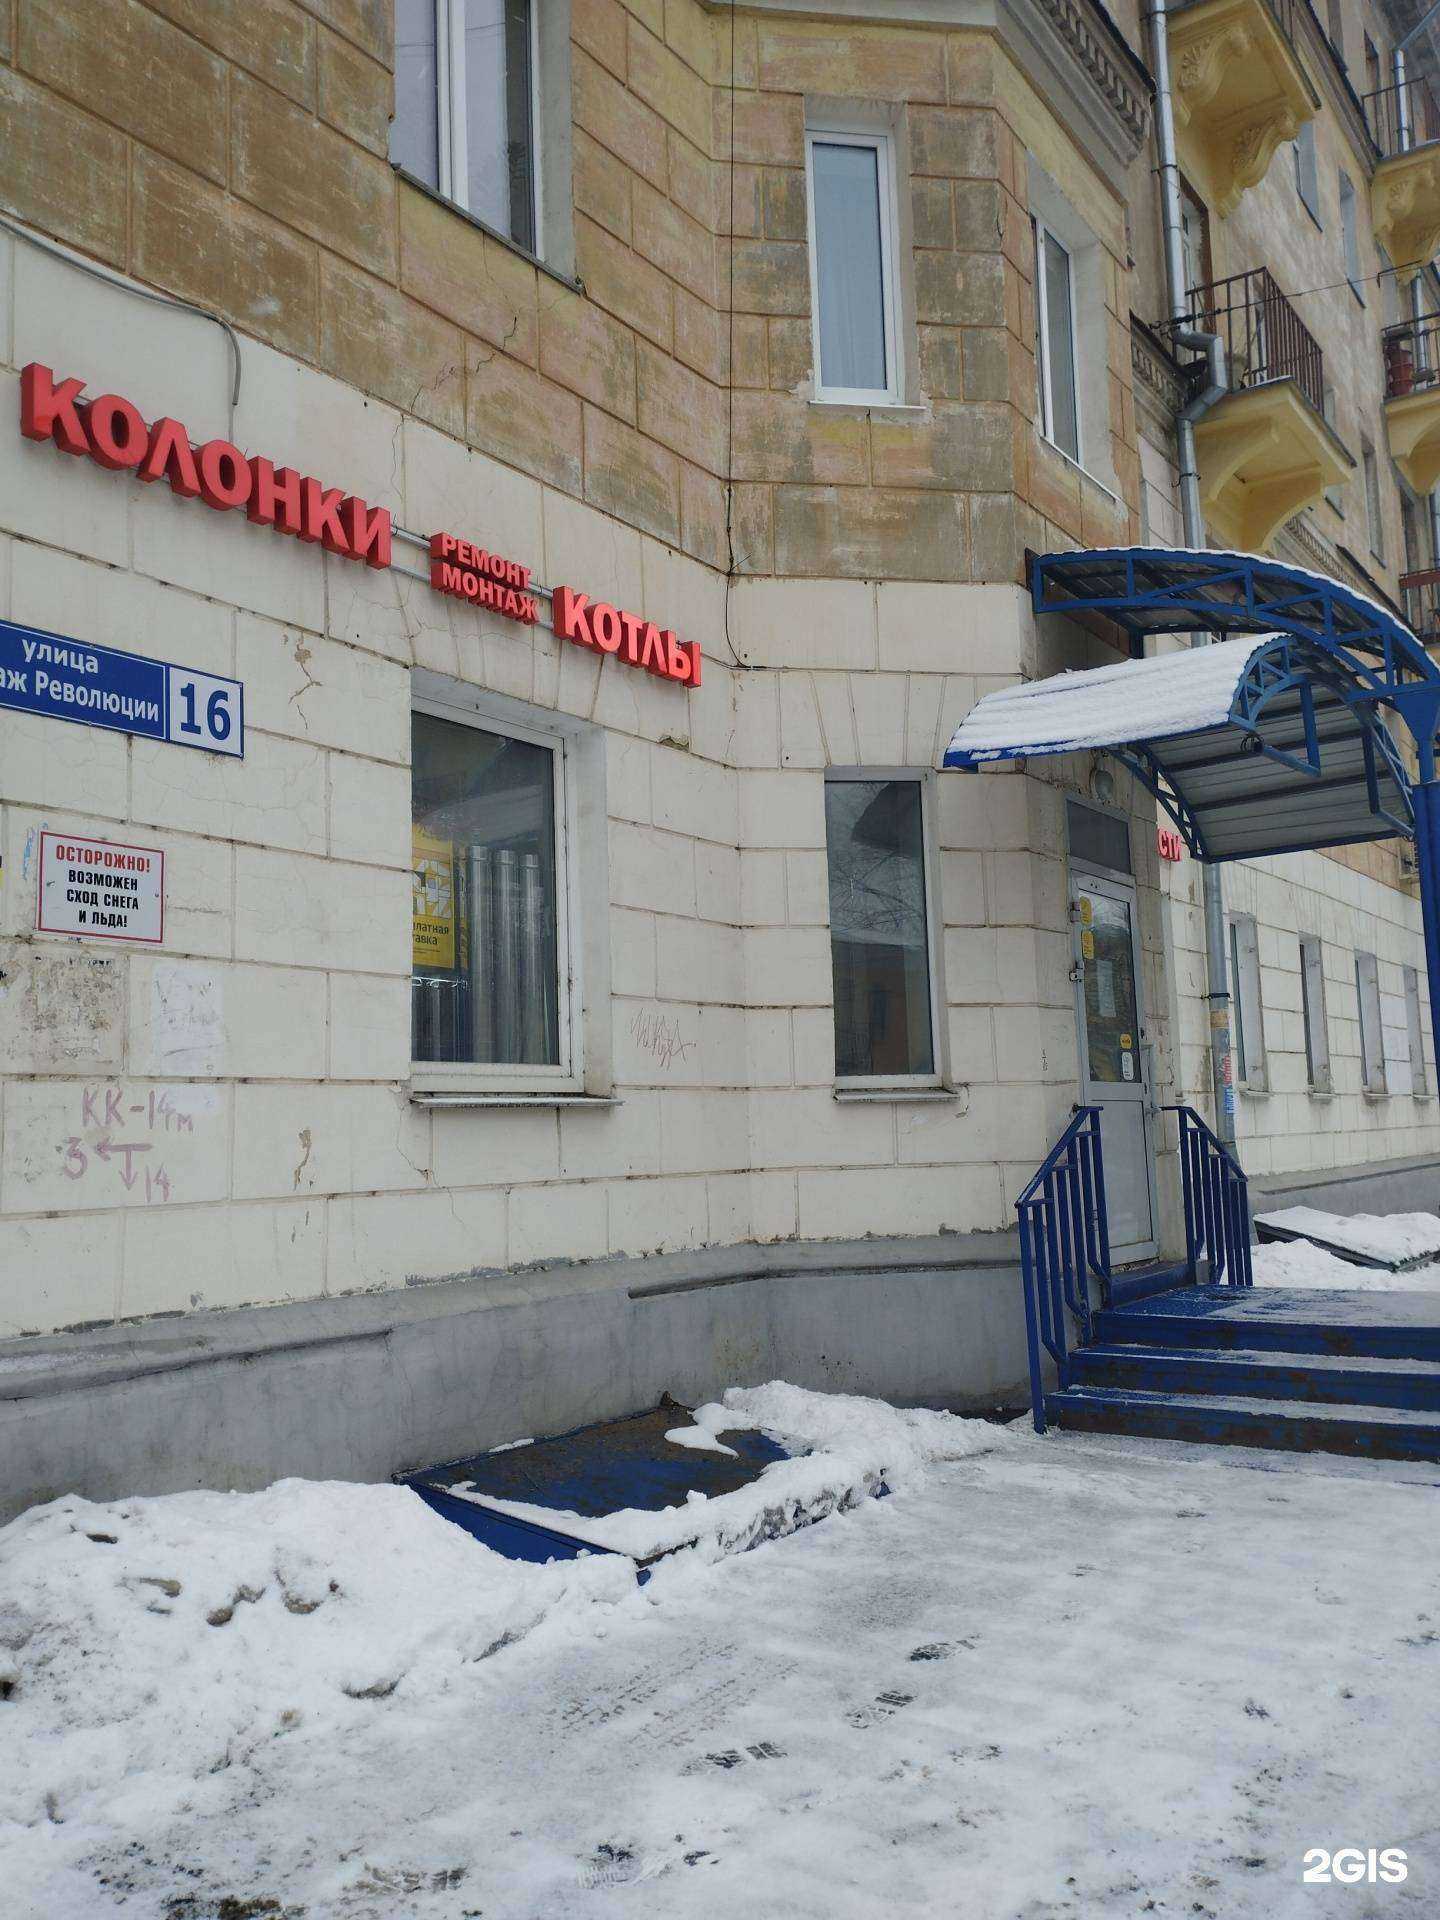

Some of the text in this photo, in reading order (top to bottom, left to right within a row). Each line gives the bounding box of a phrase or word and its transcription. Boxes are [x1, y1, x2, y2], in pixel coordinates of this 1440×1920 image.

[20, 362, 392, 570] КОЛОНКИ
[430, 532, 532, 591] РЕМОНТ
[430, 562, 540, 625] МОНТАЖ
[21, 638, 99, 674] улица
[553, 586, 701, 688] КОТЛЫ
[35, 670, 159, 722] Революции
[180, 682, 232, 741] 16
[56, 844, 151, 873] ОСТОРОЖНО!
[68, 869, 138, 891] ВОЗМОЖЕН
[66, 889, 139, 910] СХОД СНЕГА
[78, 910, 128, 928] И ЛЬДА!
